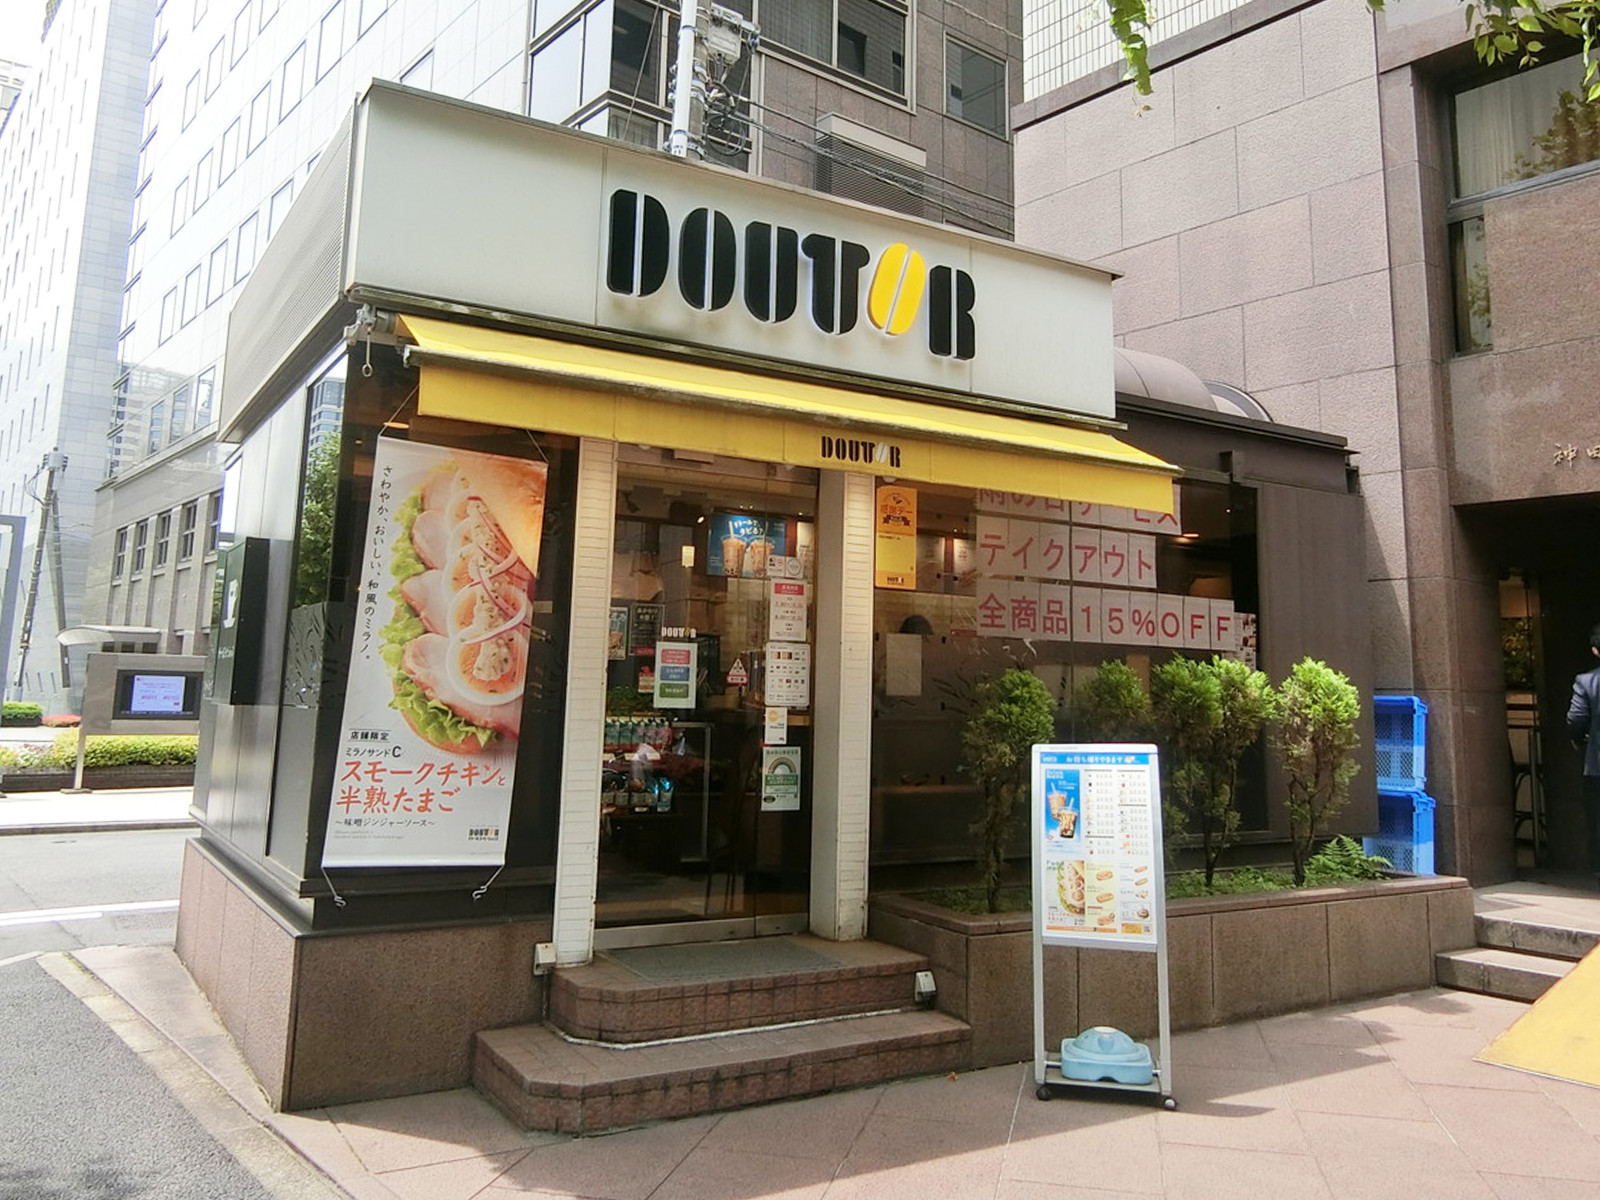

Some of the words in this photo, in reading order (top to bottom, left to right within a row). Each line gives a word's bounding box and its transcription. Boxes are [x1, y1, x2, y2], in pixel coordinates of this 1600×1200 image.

[606, 188, 976, 361] DOUTOR
[821, 435, 901, 468] DOUTOR
[359, 465, 393, 660] さわやか、おいしい、和風のミラノ。
[979, 533, 1152, 580] テイクアウト
[661, 626, 697, 638] DOUTOR
[350, 731, 390, 741] 店舗限定
[345, 745, 402, 758] ミラノサンドC
[340, 760, 506, 787] スモークチキンと
[336, 785, 461, 815] 半熟たまご
